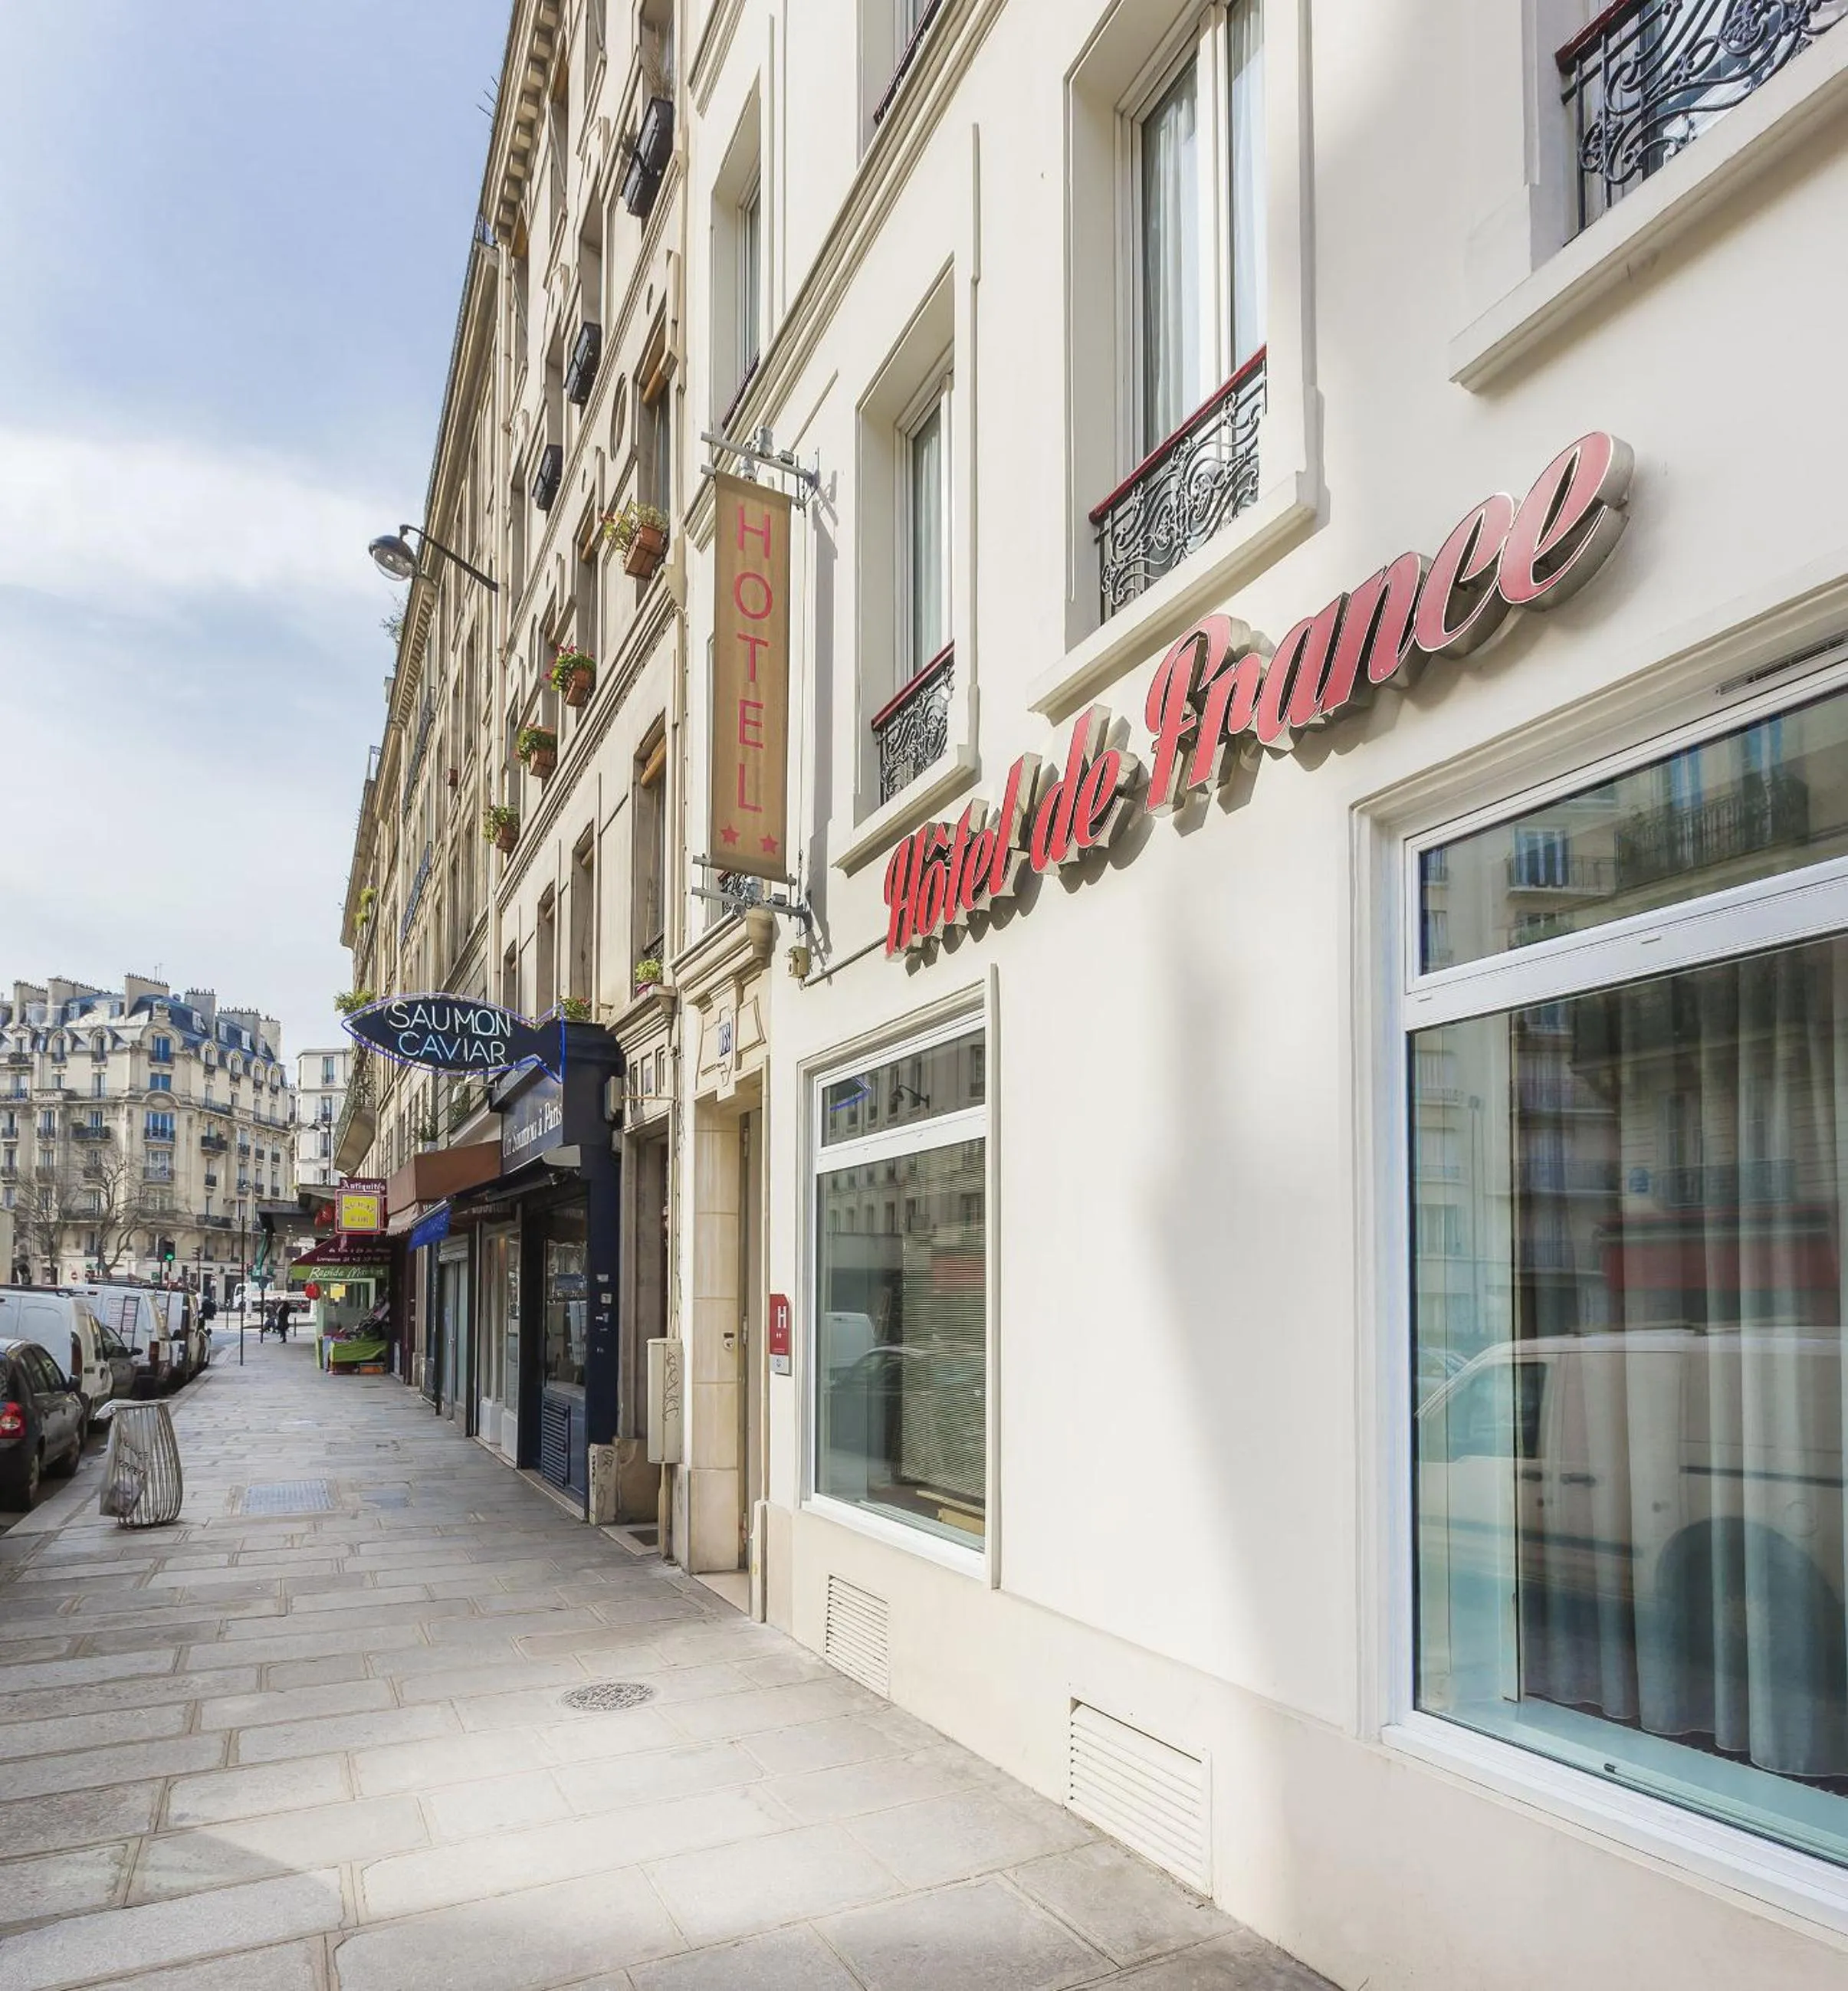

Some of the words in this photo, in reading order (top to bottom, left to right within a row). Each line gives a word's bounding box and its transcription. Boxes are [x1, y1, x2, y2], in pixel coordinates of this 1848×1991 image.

[734, 503, 773, 812] HOTEL
[883, 755, 1032, 959] Hôtel
[1029, 704, 1125, 875] de
[1144, 430, 1623, 815] France
[389, 1001, 512, 1038] SAUMON
[399, 1031, 506, 1064] CAVIAR
[543, 1102, 563, 1134] Paris
[309, 1267, 344, 1278] Rapide
[777, 1305, 787, 1328] H
